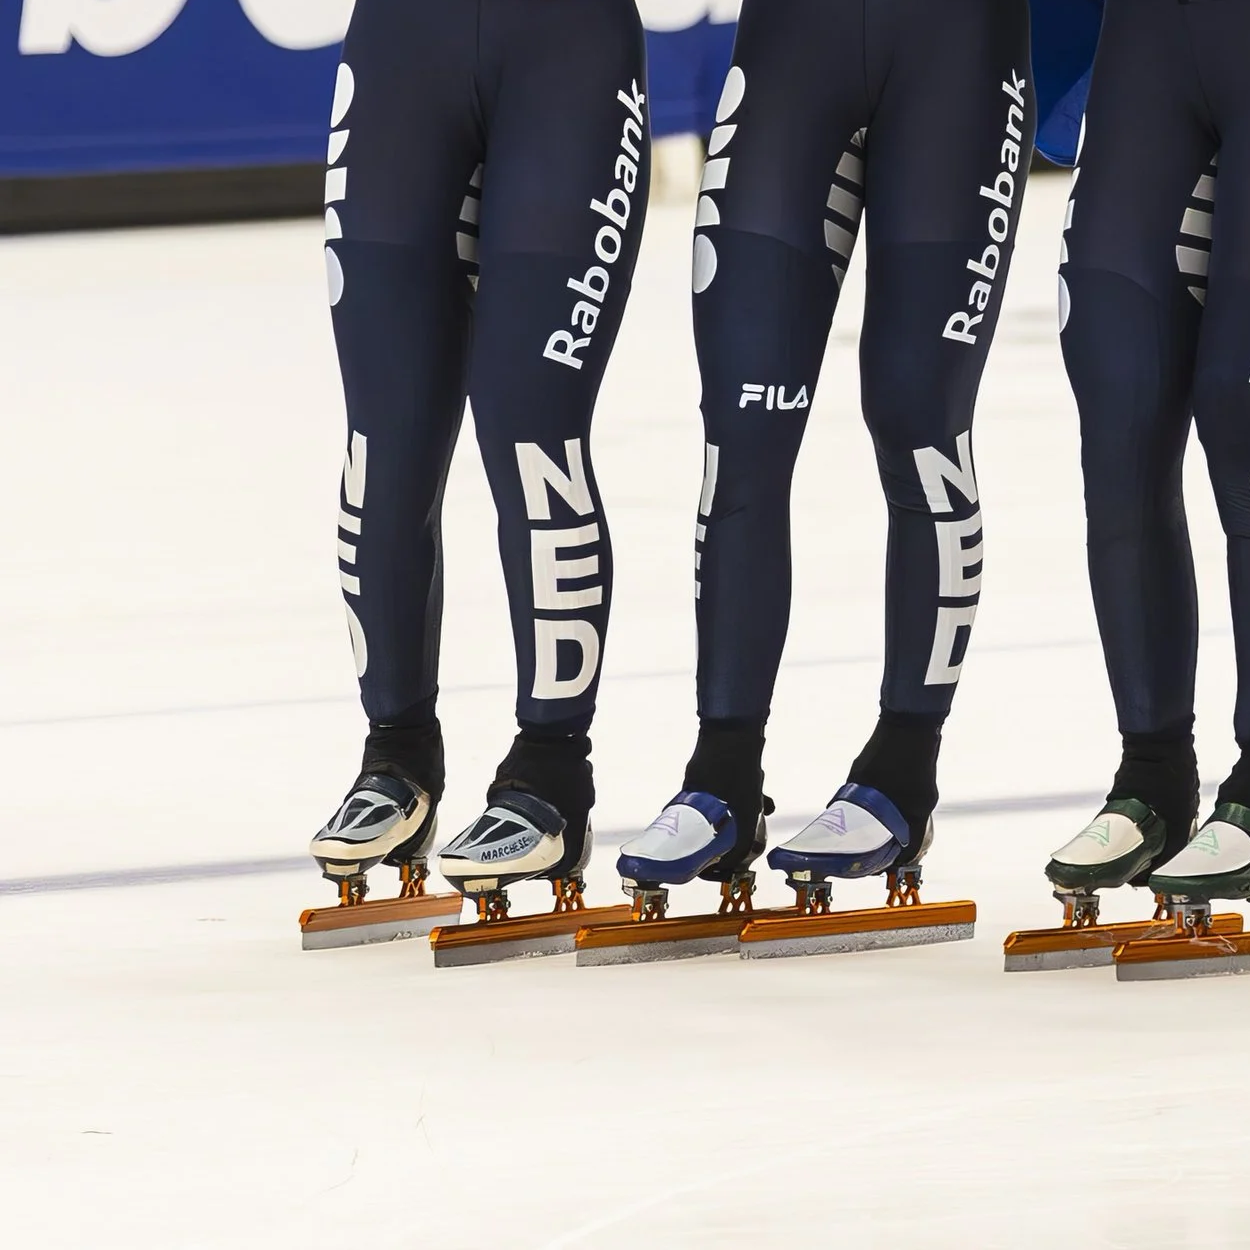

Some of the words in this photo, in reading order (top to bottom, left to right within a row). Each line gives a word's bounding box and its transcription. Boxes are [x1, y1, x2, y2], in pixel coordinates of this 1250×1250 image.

[541, 77, 647, 370] Rabobank
[941, 68, 1026, 345] Rabobank
[738, 383, 810, 411] FILA
[514, 437, 604, 701] NED
[912, 430, 985, 687] NED
